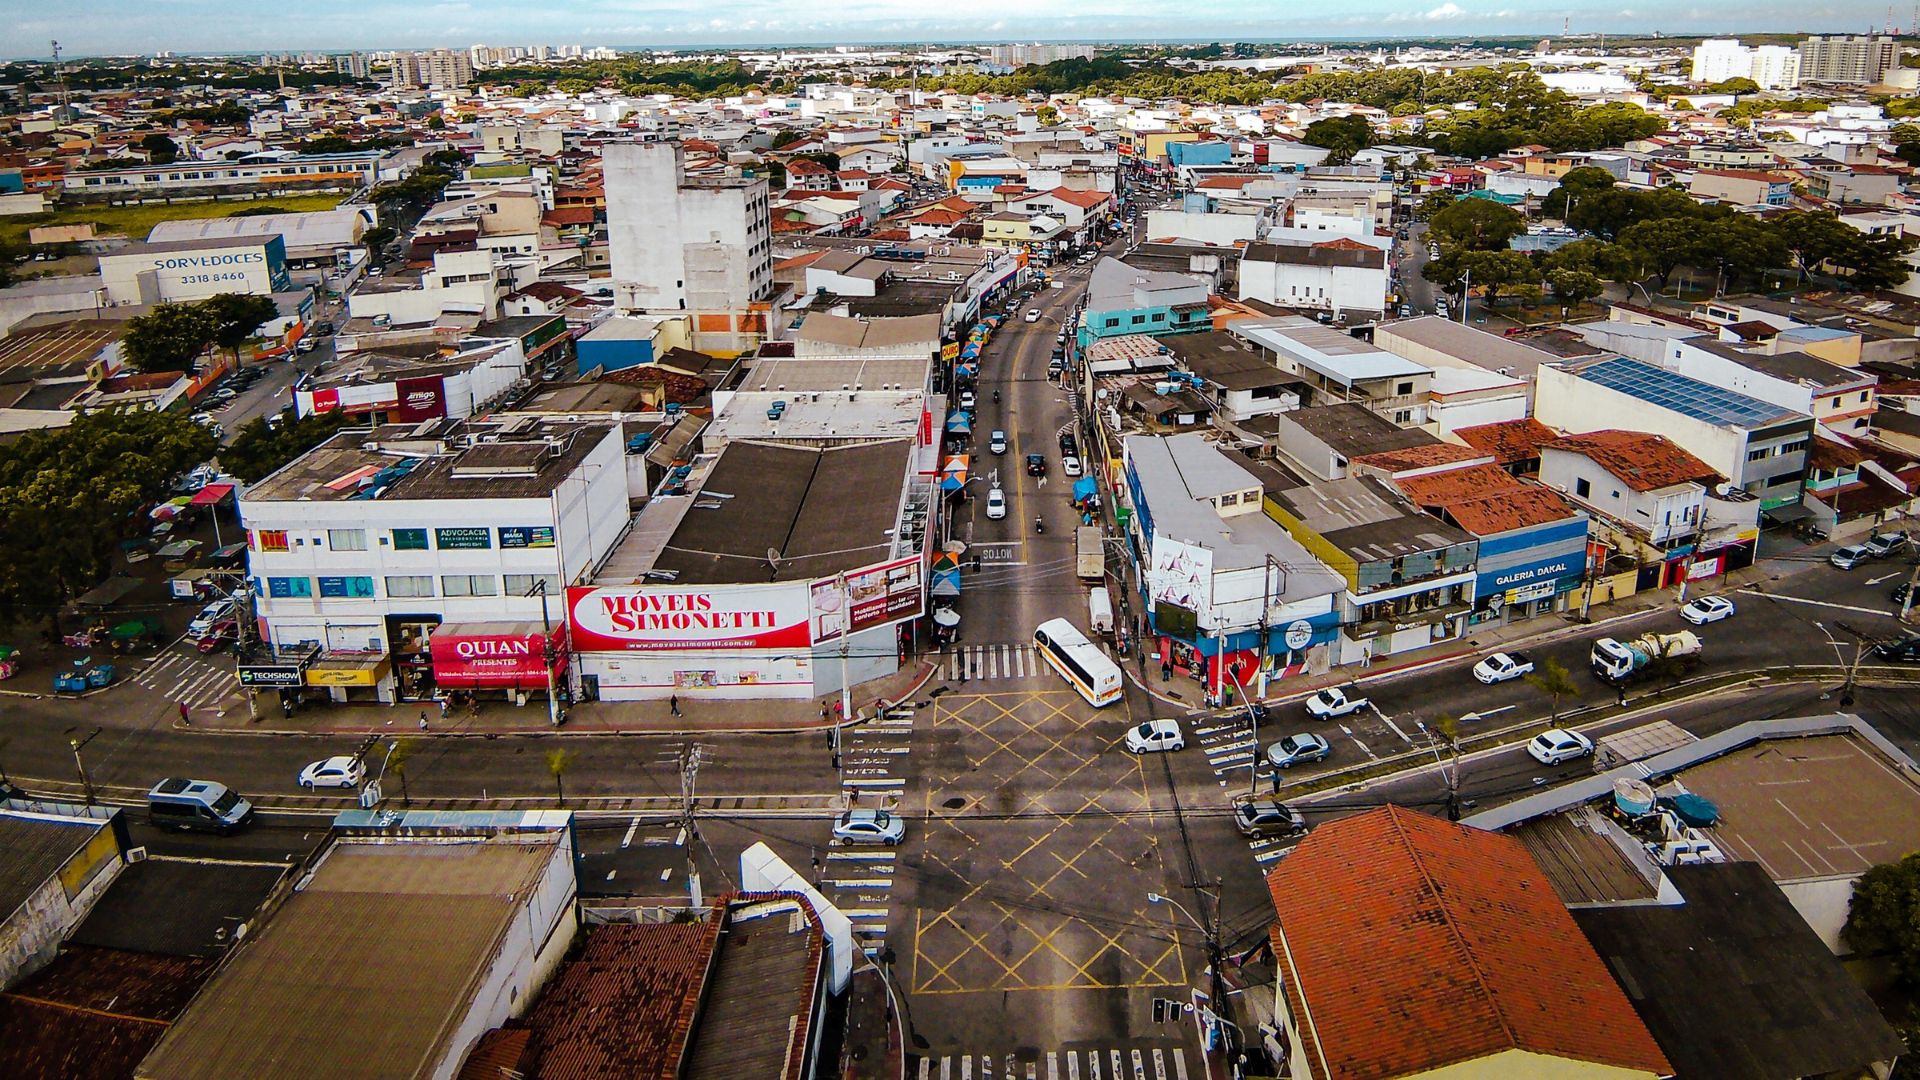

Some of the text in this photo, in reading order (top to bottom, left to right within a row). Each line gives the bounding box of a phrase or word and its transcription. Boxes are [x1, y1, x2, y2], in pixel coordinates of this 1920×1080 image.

[154, 253, 263, 269] SORVEDOCES
[181, 272, 245, 284] 3318 8460
[943, 344, 958, 357] OURO
[440, 529, 487, 537] ADVOCACIA
[982, 549, 1012, 559] MOTOS
[1496, 563, 1567, 585] GALERIA DAKAL
[601, 590, 711, 615] MÓVEIS
[853, 603, 887, 616] Mobiliando
[854, 610, 880, 621] conforto
[887, 599, 915, 612] qualidade
[611, 611, 776, 632] SIMONETTI
[456, 640, 529, 657] QUIAN
[629, 640, 753, 648] www.moveissimonetti.com.br
